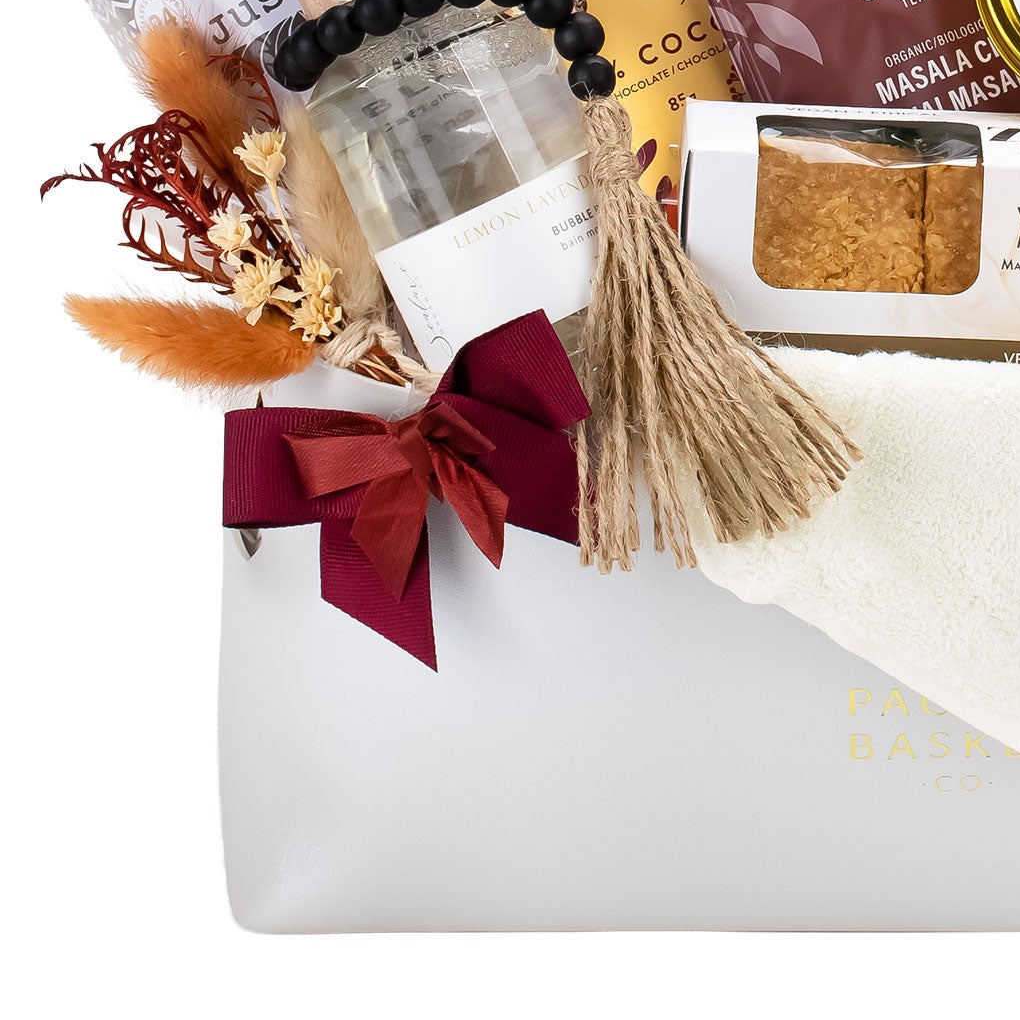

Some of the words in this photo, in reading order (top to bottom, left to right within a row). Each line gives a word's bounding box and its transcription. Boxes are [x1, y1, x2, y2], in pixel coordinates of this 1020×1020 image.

[614, 69, 670, 100] HOCOLATE
[875, 48, 974, 105] MASALA
[452, 206, 521, 250] LEMON
[527, 175, 589, 215] LAVEND
[551, 208, 594, 236] BUBBLE
[561, 234, 584, 250] bain
